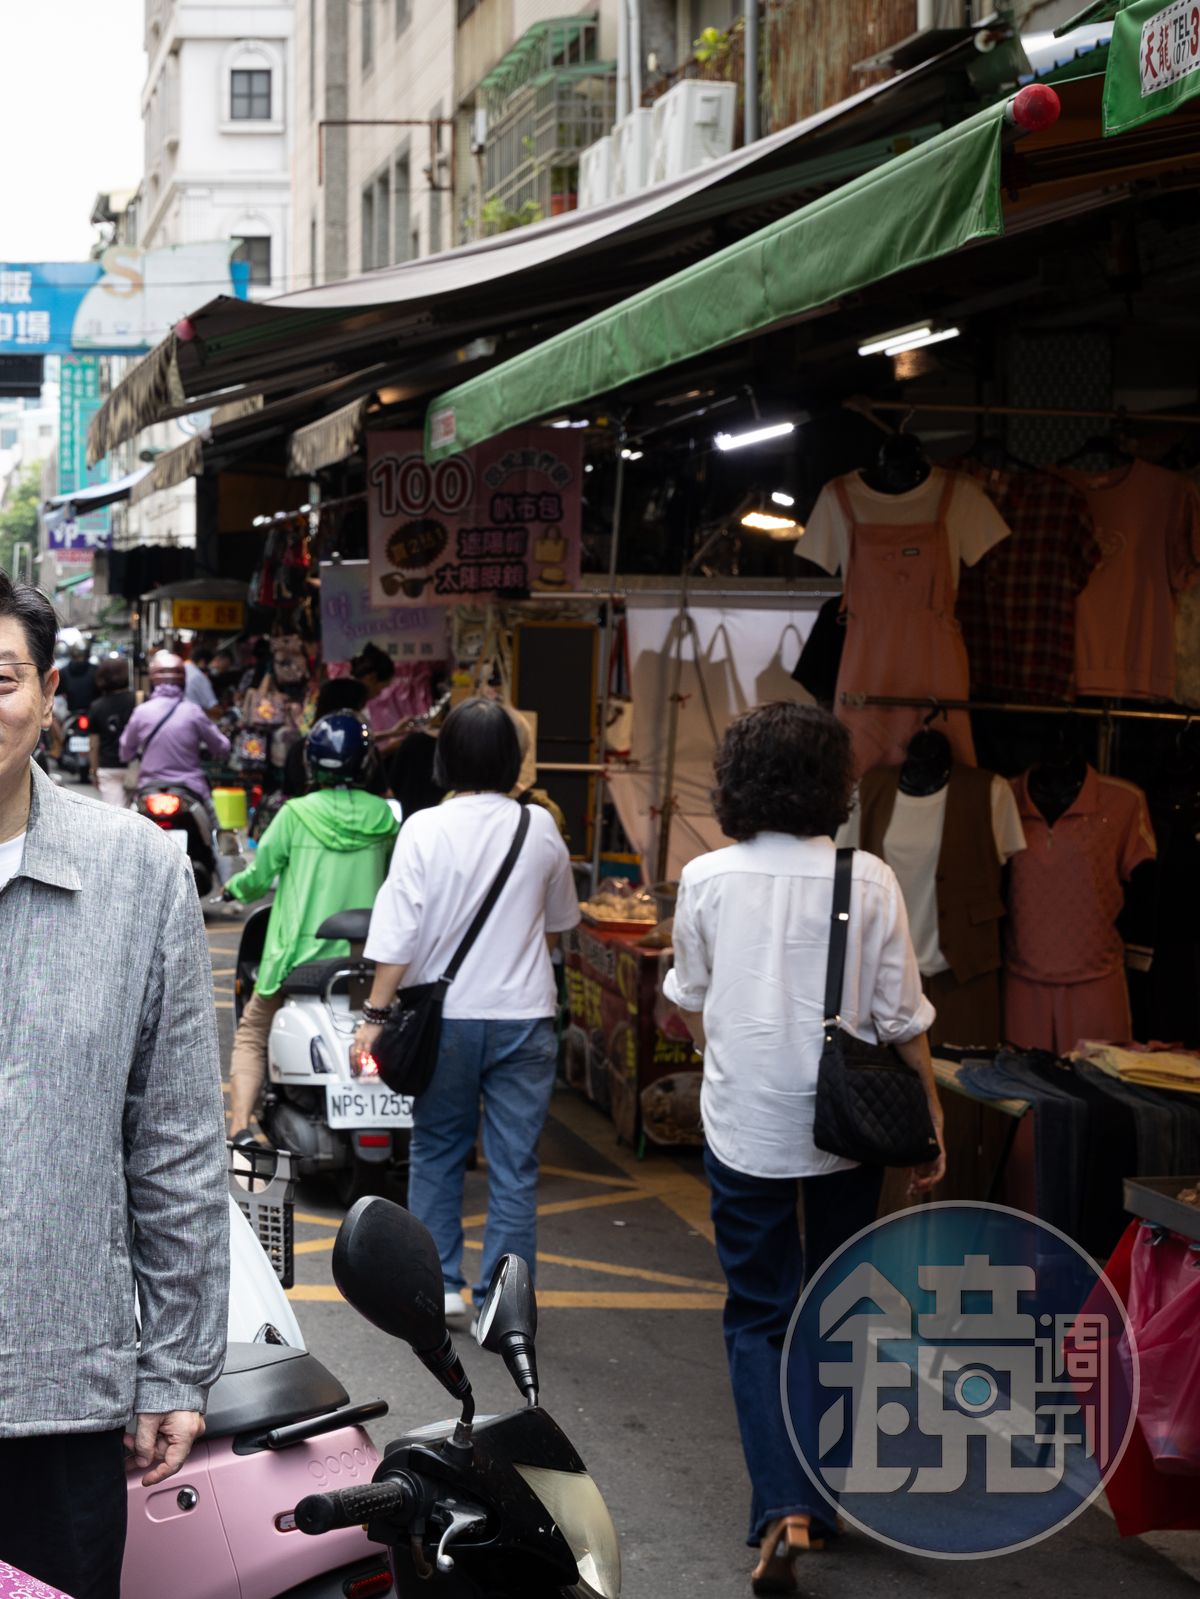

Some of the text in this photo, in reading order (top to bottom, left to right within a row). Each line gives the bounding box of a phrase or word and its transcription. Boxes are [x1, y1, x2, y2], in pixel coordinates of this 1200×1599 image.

[1173, 12, 1190, 43] TEL
[1173, 39, 1190, 66] (07)
[371, 455, 473, 516] 100
